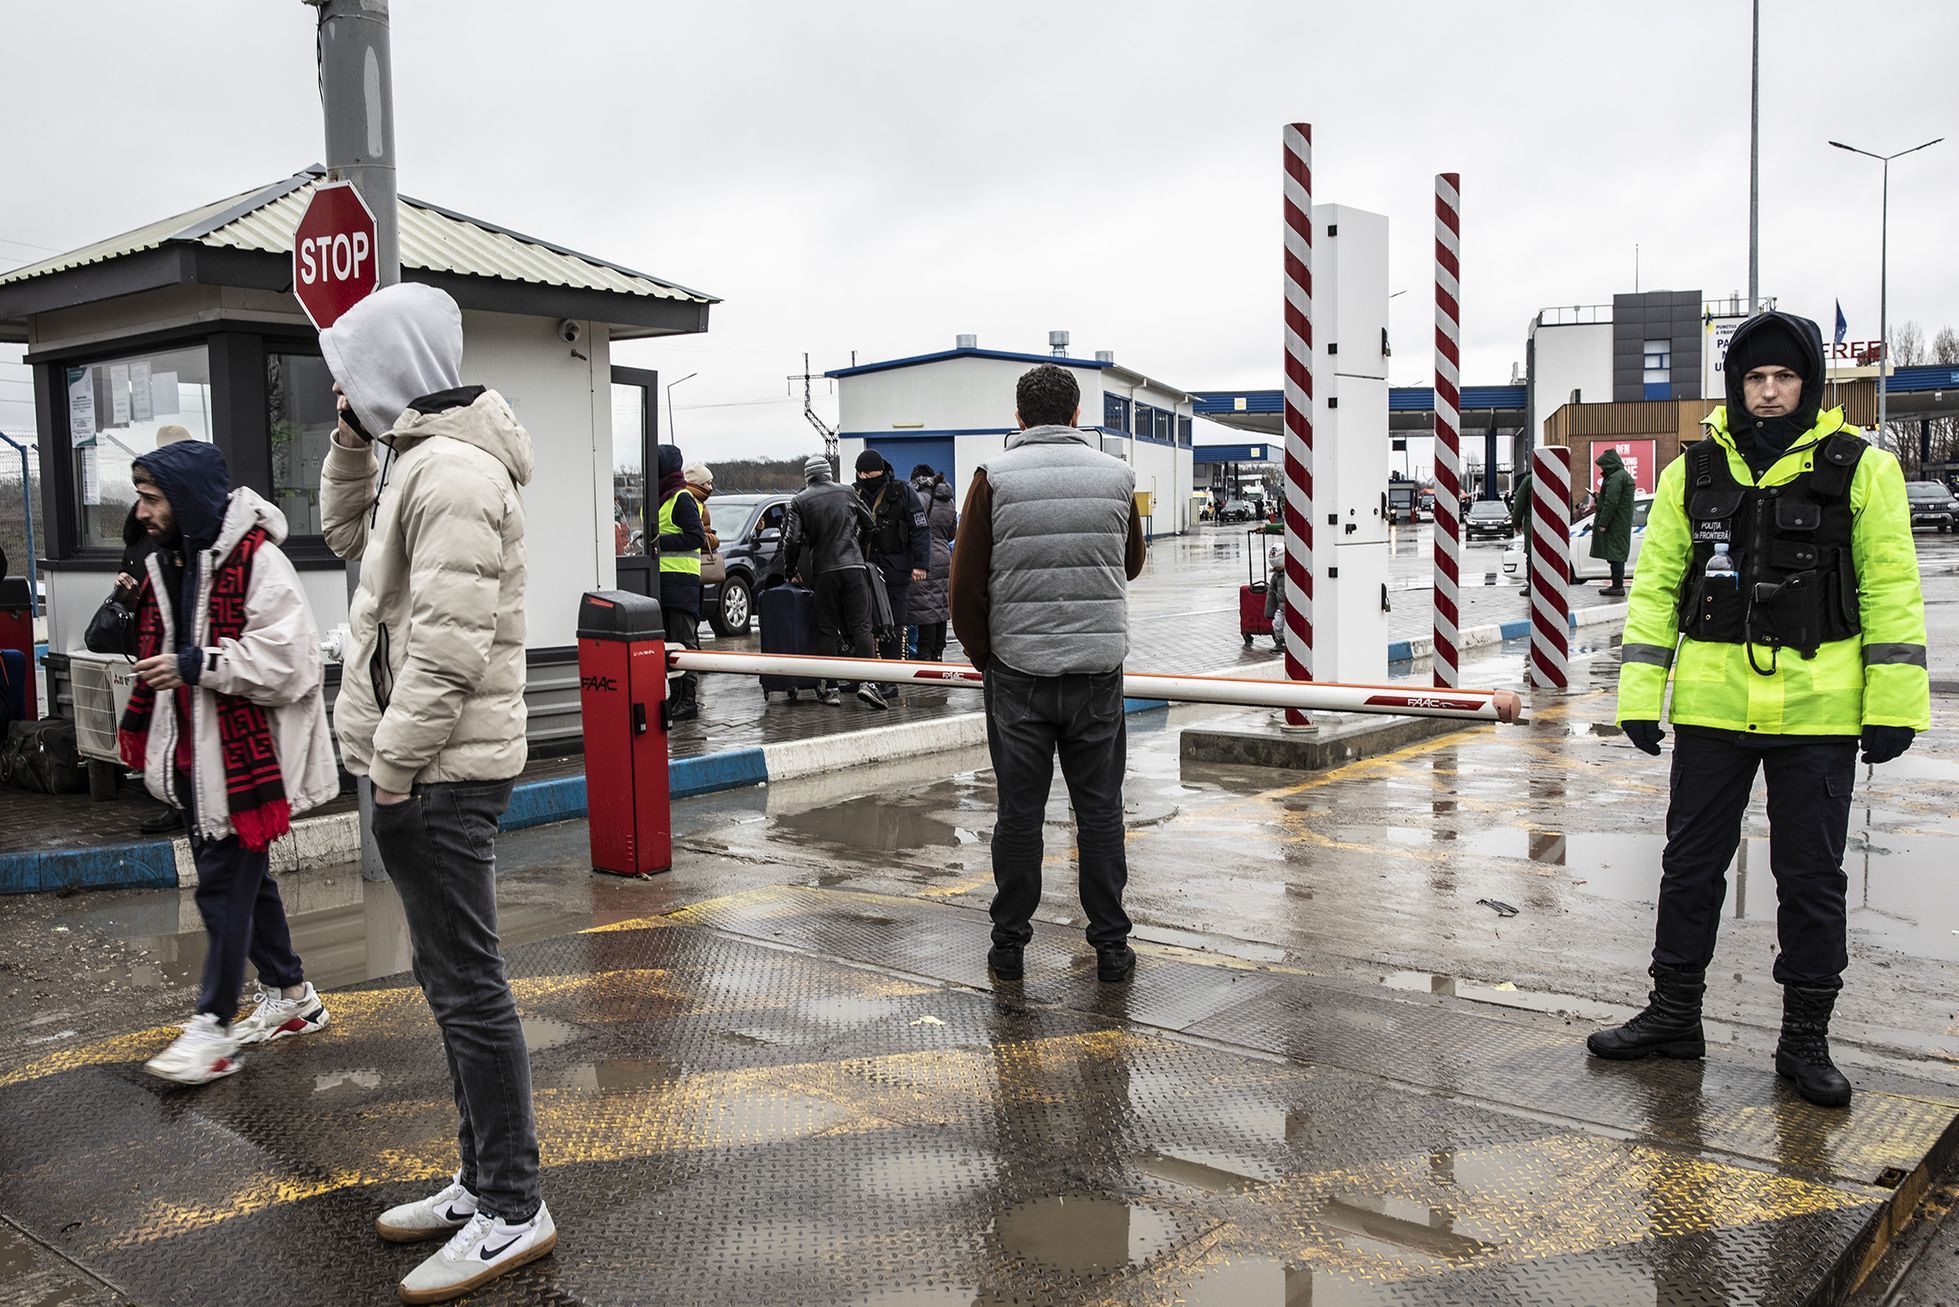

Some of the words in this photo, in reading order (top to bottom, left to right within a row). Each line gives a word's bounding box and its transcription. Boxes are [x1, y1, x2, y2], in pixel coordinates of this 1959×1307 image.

[301, 232, 369, 285] STOP
[1717, 339, 1730, 348] PA
[581, 676, 617, 692] FAAC
[1407, 697, 1440, 708] FAAC
